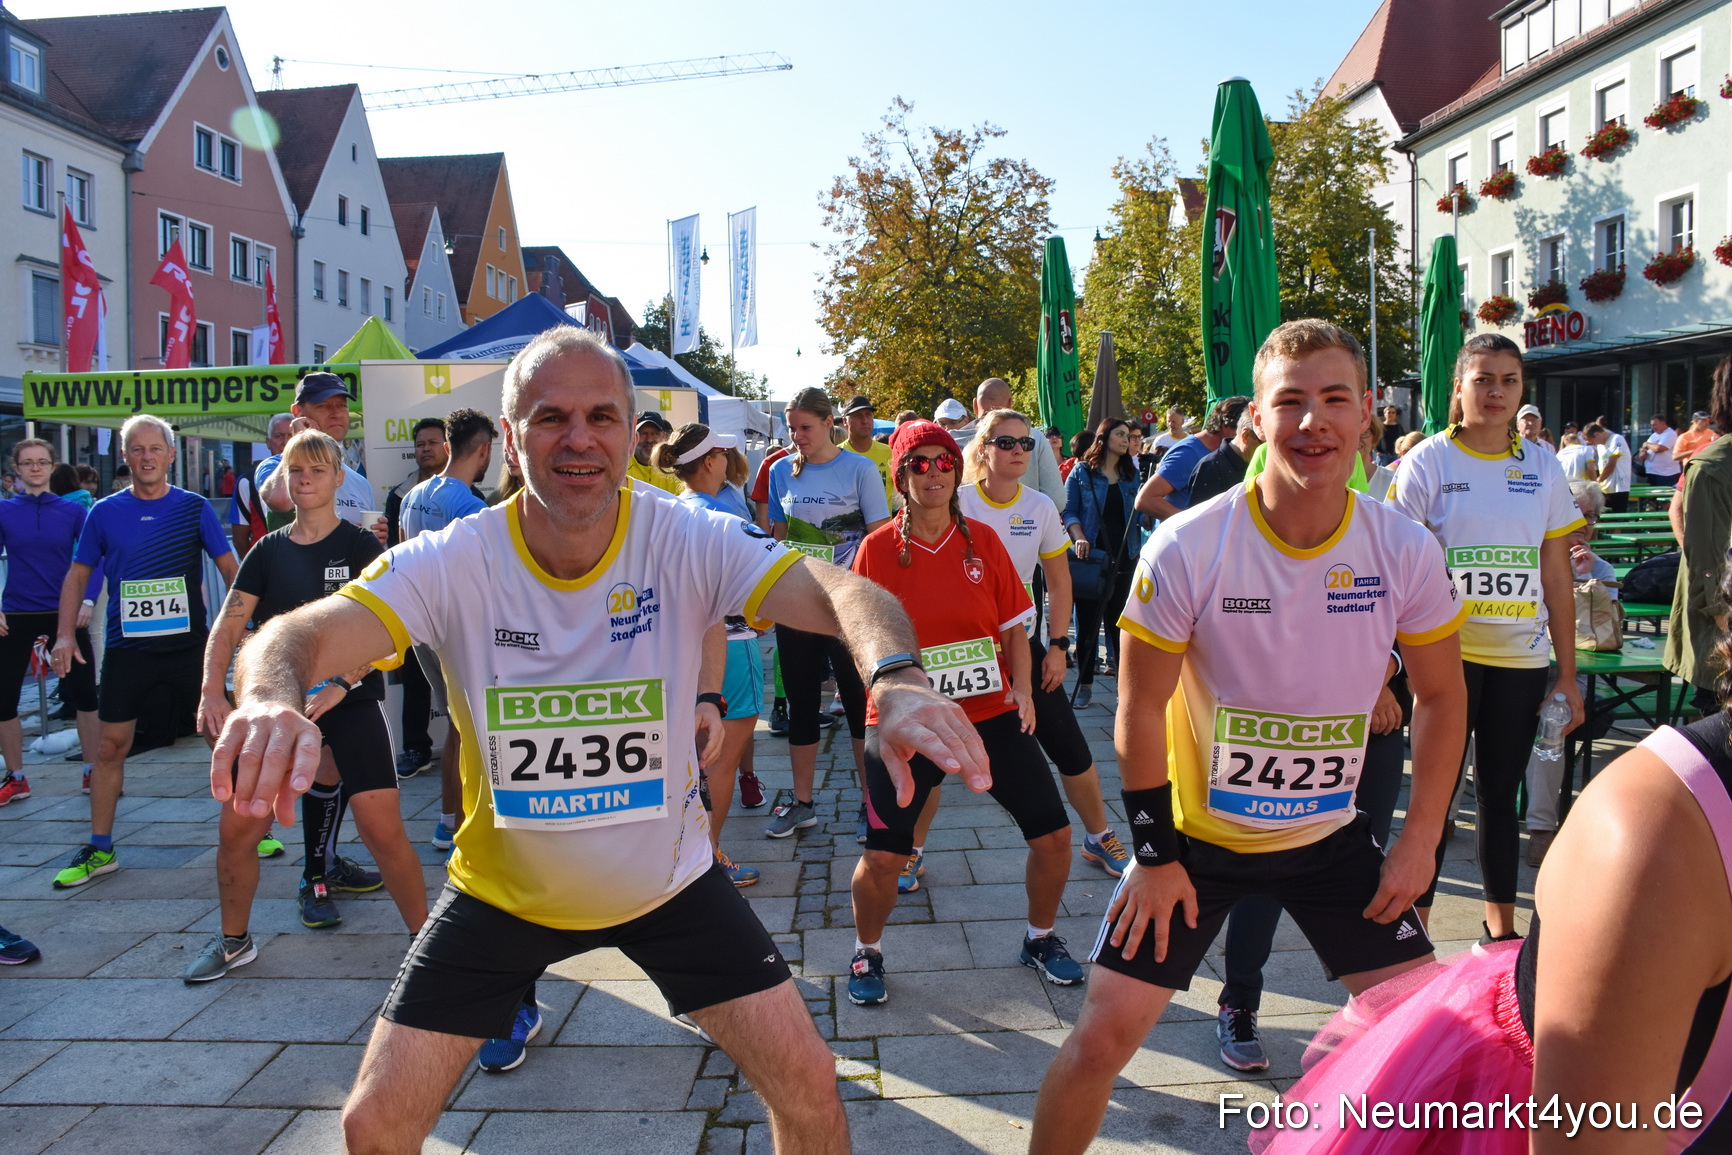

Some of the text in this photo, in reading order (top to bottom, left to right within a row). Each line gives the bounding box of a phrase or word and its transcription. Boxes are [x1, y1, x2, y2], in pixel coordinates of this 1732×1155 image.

[1523, 310, 1586, 349] RENO
[1507, 469, 1522, 479] 20
[1010, 517, 1022, 525] 20
[1454, 547, 1533, 566] BOCK
[328, 568, 347, 579] BRL
[1328, 570, 1379, 589] 20 JAHRE
[125, 581, 181, 596] BOCK
[1460, 572, 1529, 596] 1367
[609, 588, 635, 613] 20
[1223, 597, 1271, 609] BOCK
[1327, 589, 1387, 600] Neumarkter
[128, 598, 181, 617] 2814
[1326, 601, 1376, 613] Stadtlauf
[1471, 601, 1525, 621] NANCY
[494, 628, 540, 646] OCK
[499, 685, 651, 725] BOCK
[1225, 712, 1355, 746] BOCK
[509, 732, 648, 781] 2436
[652, 733, 659, 741] D
[1227, 752, 1345, 790] 2423
[529, 789, 630, 814] MARTIN
[1244, 800, 1319, 816] JONAS
[315, 800, 336, 857] Kalenji
[1396, 929, 1418, 940] adidas
